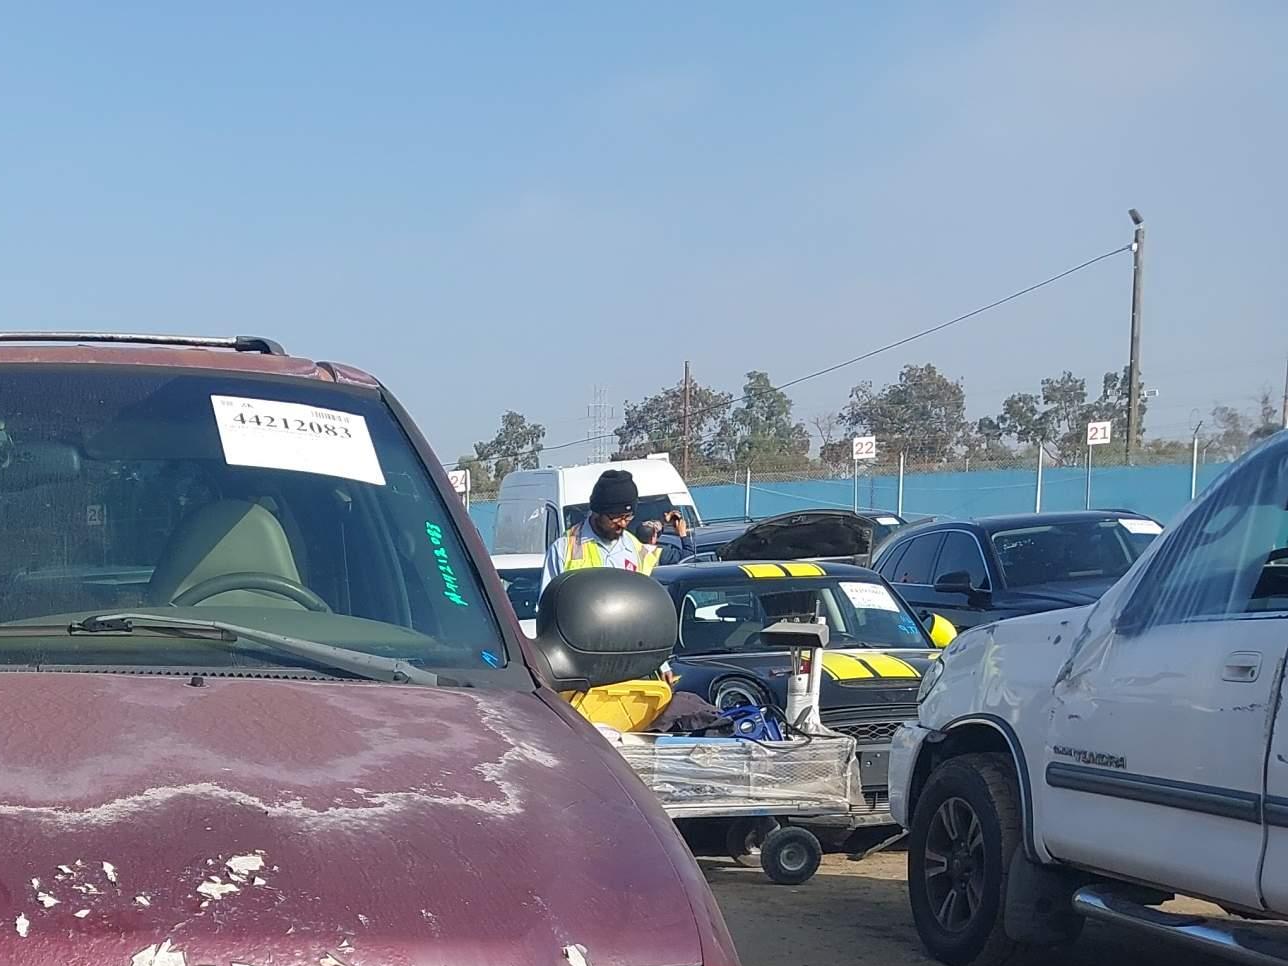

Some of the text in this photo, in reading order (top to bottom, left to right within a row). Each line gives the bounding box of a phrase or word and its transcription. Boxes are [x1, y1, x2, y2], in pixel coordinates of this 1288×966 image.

[233, 411, 352, 439] 44212083
[1089, 426, 1108, 441] 21
[854, 441, 874, 455] 22
